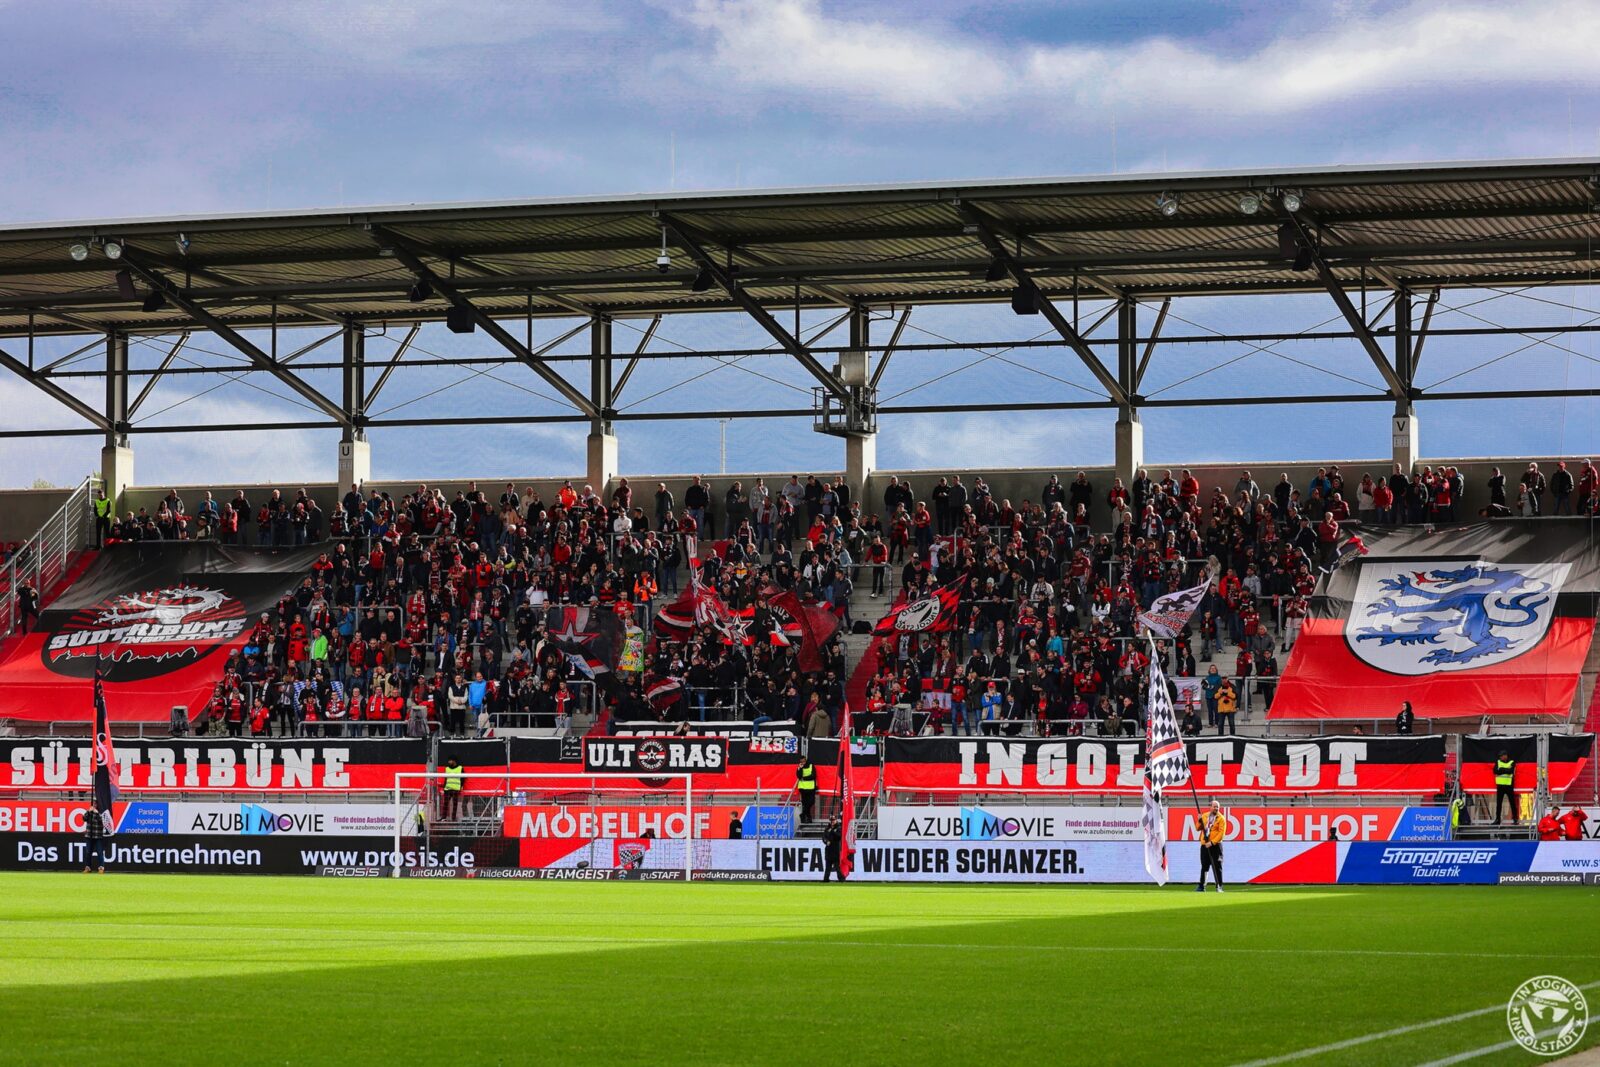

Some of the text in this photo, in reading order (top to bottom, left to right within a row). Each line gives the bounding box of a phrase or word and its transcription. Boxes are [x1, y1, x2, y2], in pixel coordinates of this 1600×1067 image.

[1397, 421, 1406, 432] V
[342, 445, 350, 456] U
[48, 618, 247, 650] SÜDTRIBÜNE
[751, 736, 784, 752] FKS
[959, 742, 1367, 787] INGOLTADT
[191, 813, 324, 832] AZUBI MOVIE
[333, 816, 396, 824] Finde deine Ausbildun
[1065, 819, 1140, 829] Finde deine Ausbildung!
[905, 817, 1054, 837] AZUBI MOVIE
[1413, 824, 1444, 833] Ingolstad
[17, 841, 59, 862] Das
[300, 846, 475, 867] www.prosis.de
[1380, 847, 1499, 866] Stanglmeier
[761, 847, 1085, 874] EINFA WIEDER SCHANZER.
[409, 868, 456, 878] luitGUARD
[479, 868, 536, 879] hildeGUARD
[539, 869, 613, 879] TEAMGEIST
[640, 871, 680, 881] guSTAFF
[692, 871, 768, 880] produkte.prosis.de
[1411, 866, 1461, 877] Touristik
[1499, 874, 1581, 883] produkte.prosis.de
